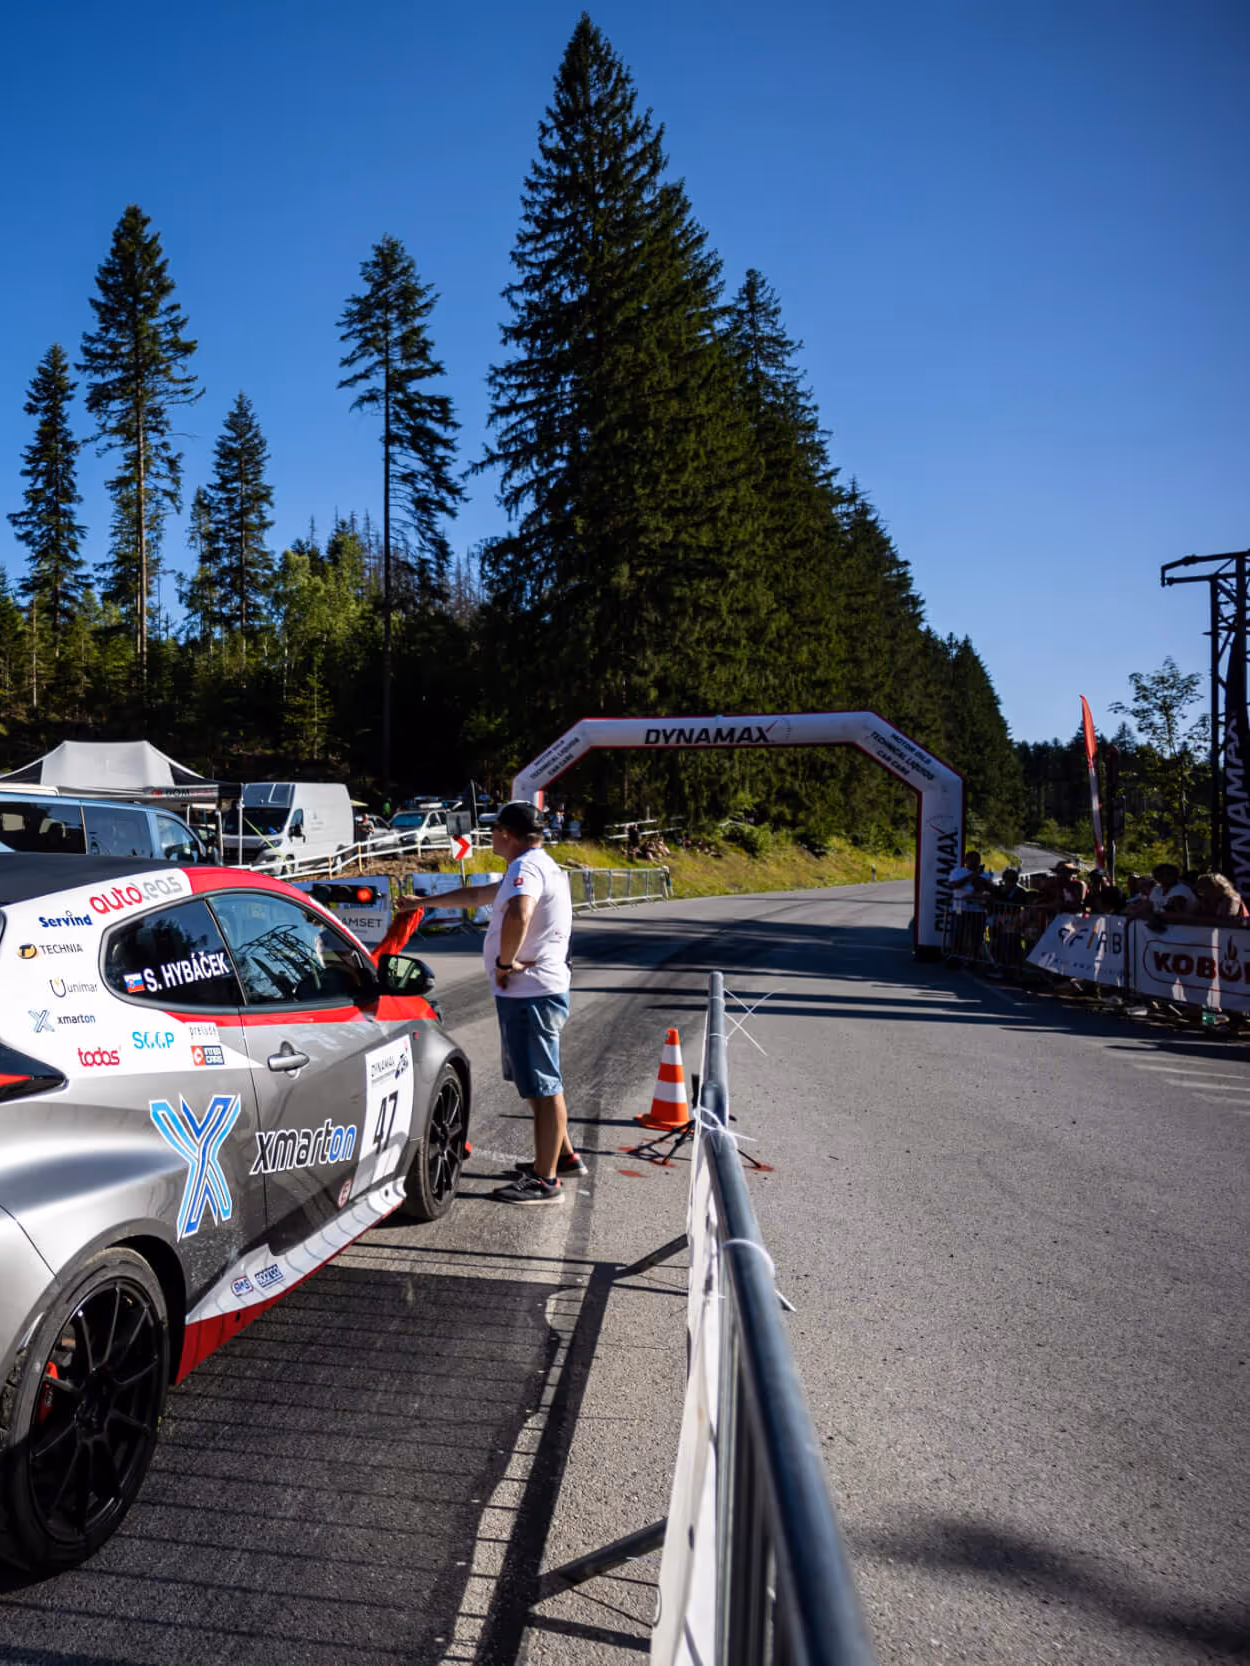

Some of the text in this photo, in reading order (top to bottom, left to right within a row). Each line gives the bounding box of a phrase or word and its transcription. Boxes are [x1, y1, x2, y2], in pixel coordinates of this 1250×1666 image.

[645, 727, 769, 744] DYNAMAX
[89, 876, 183, 914] autoleas
[38, 911, 93, 928] Servind
[39, 944, 83, 955] TECHNIA
[143, 951, 230, 993] S. HYBÁČEK
[57, 1013, 96, 1025] xmarton
[77, 1048, 120, 1067] todos
[373, 1090, 398, 1155] 47
[249, 1118, 357, 1175] xmarton
